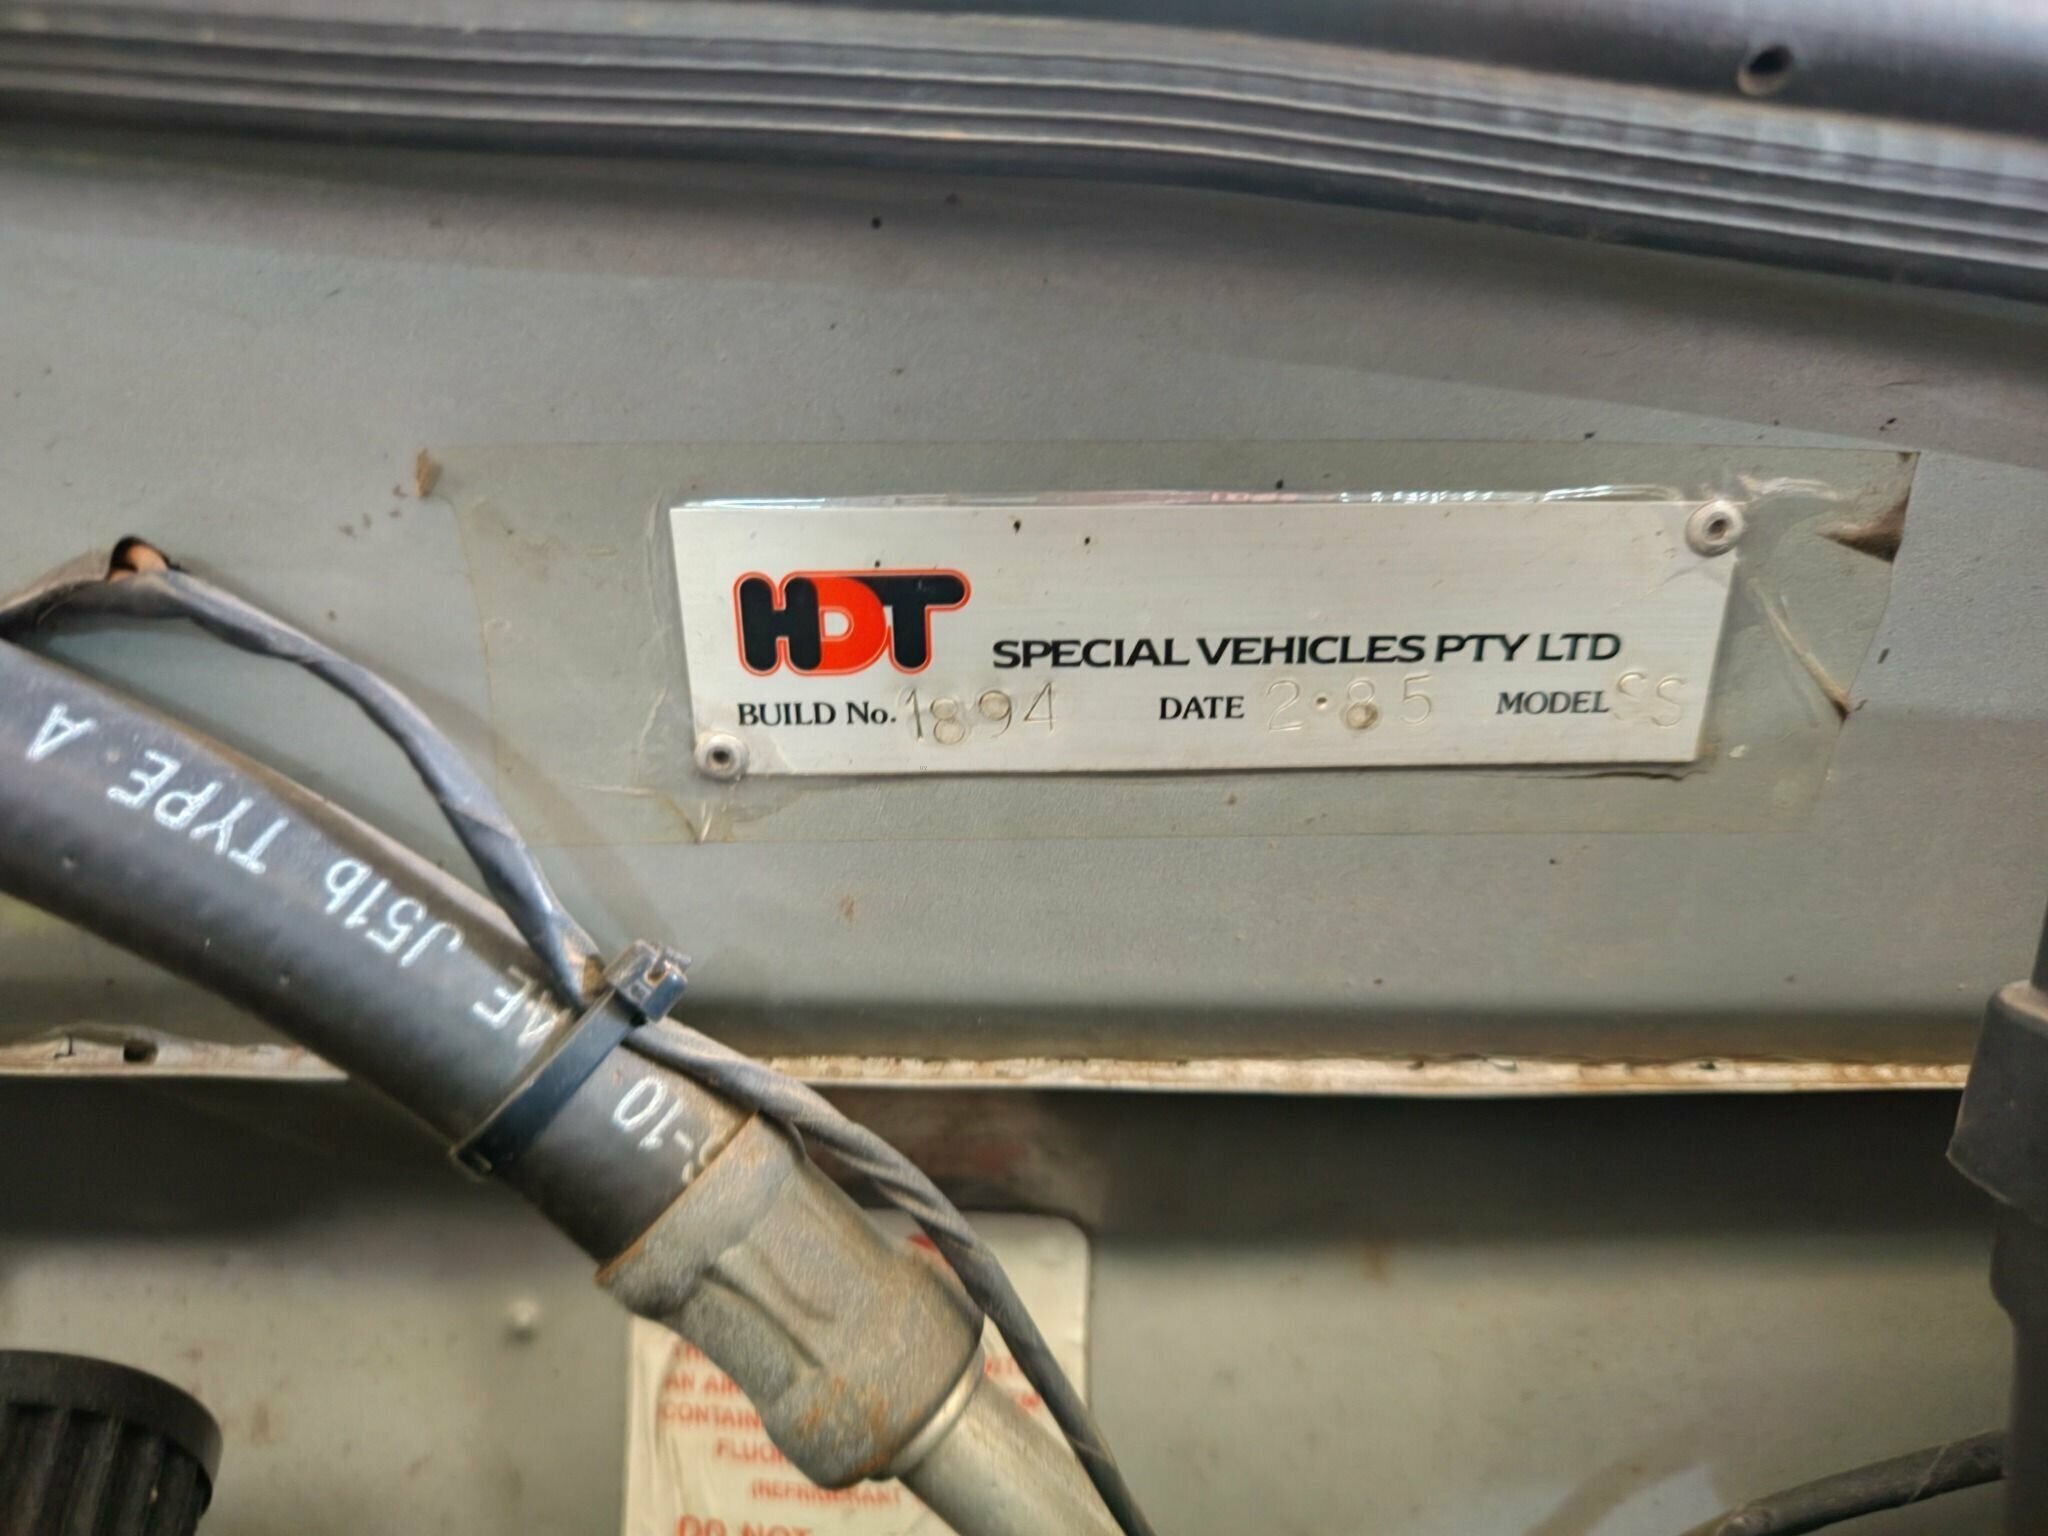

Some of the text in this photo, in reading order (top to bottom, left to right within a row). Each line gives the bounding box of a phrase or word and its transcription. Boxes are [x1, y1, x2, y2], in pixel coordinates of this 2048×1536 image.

[733, 568, 971, 676] HDT
[992, 632, 1622, 669] SPECIAL VEHICLES PTY LTD
[25, 703, 98, 763] A
[737, 702, 837, 727] BUILD
[846, 701, 898, 726] No.
[903, 681, 1059, 746] 1894
[1158, 696, 1246, 721] DATE
[1496, 690, 1610, 716] MODEL
[106, 749, 289, 875] TYPE
